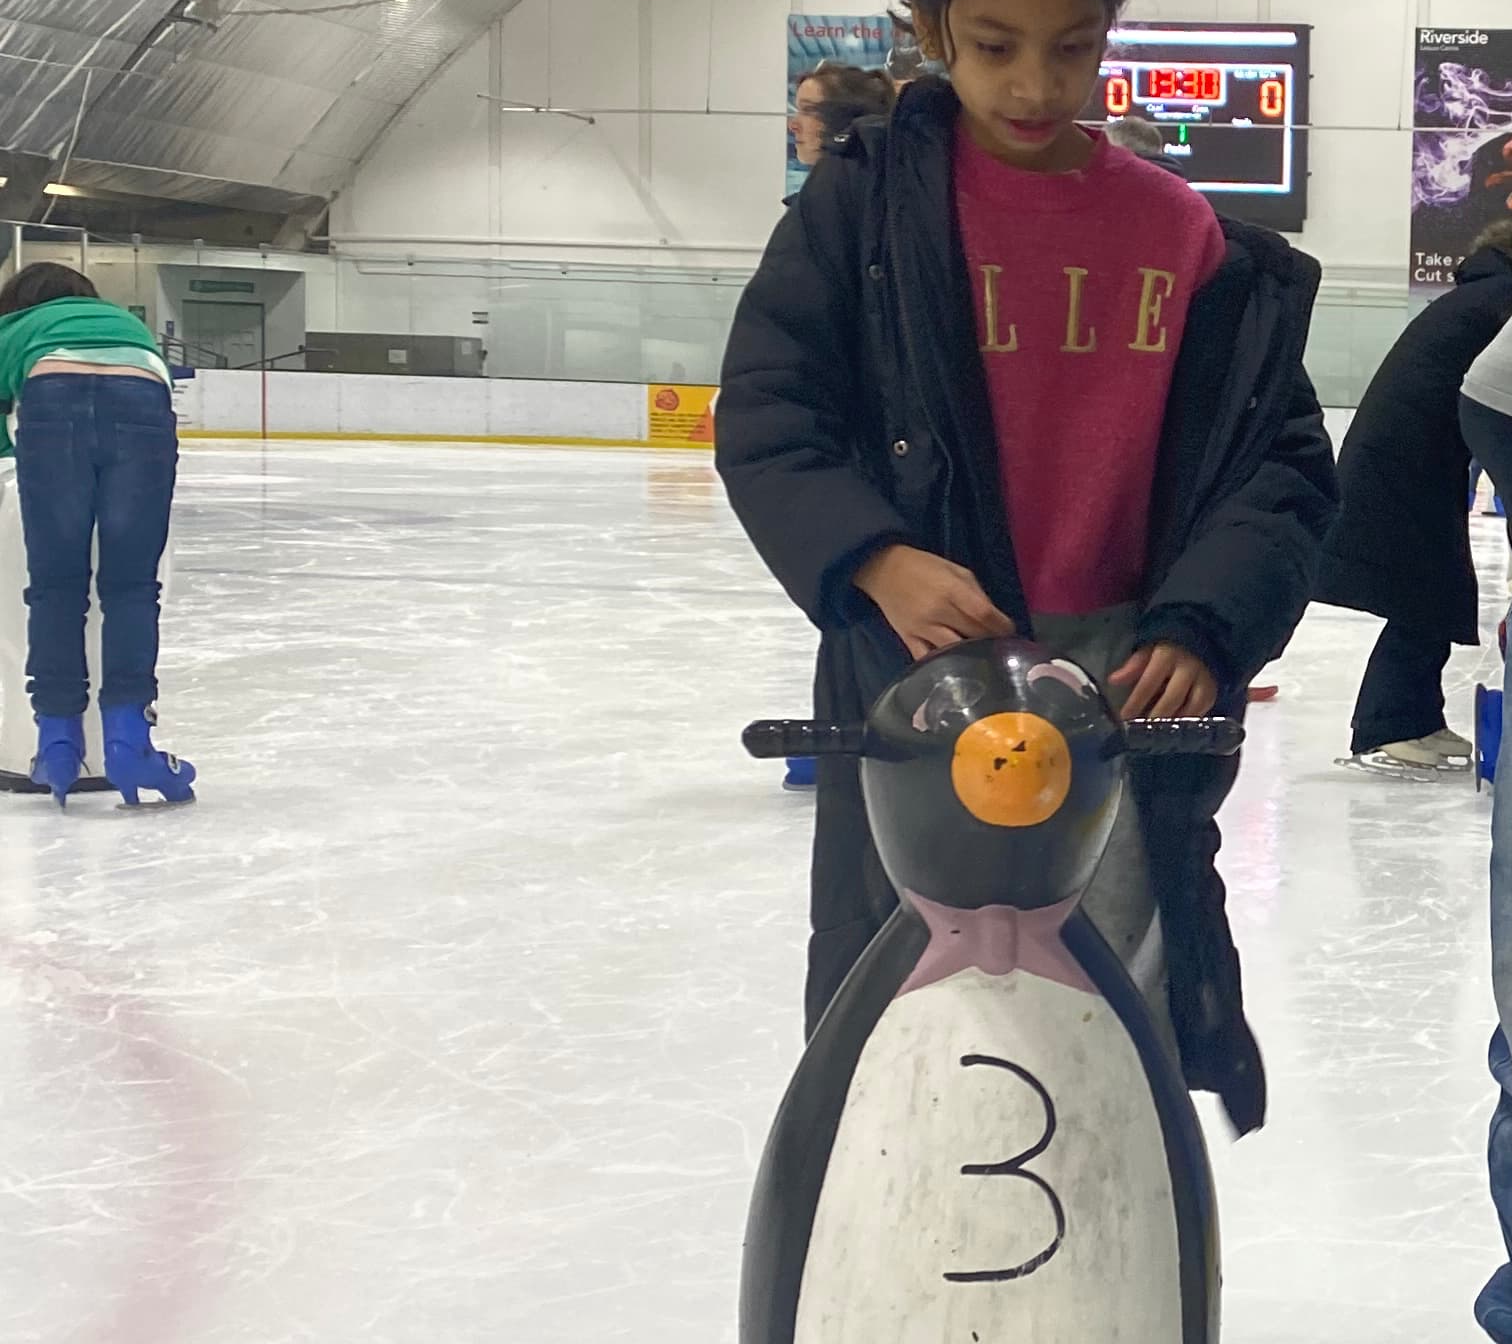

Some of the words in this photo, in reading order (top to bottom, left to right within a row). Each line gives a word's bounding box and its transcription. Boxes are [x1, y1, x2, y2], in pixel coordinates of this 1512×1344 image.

[792, 20, 845, 38] Learn
[852, 23, 883, 39] the
[1420, 29, 1489, 44] Riverside
[1106, 77, 1129, 113] 0
[1150, 68, 1220, 99] 13:30
[1260, 80, 1283, 117] 0
[1415, 252, 1453, 266] Take
[1414, 268, 1442, 282] Cut
[942, 1053, 1066, 1282] 3
